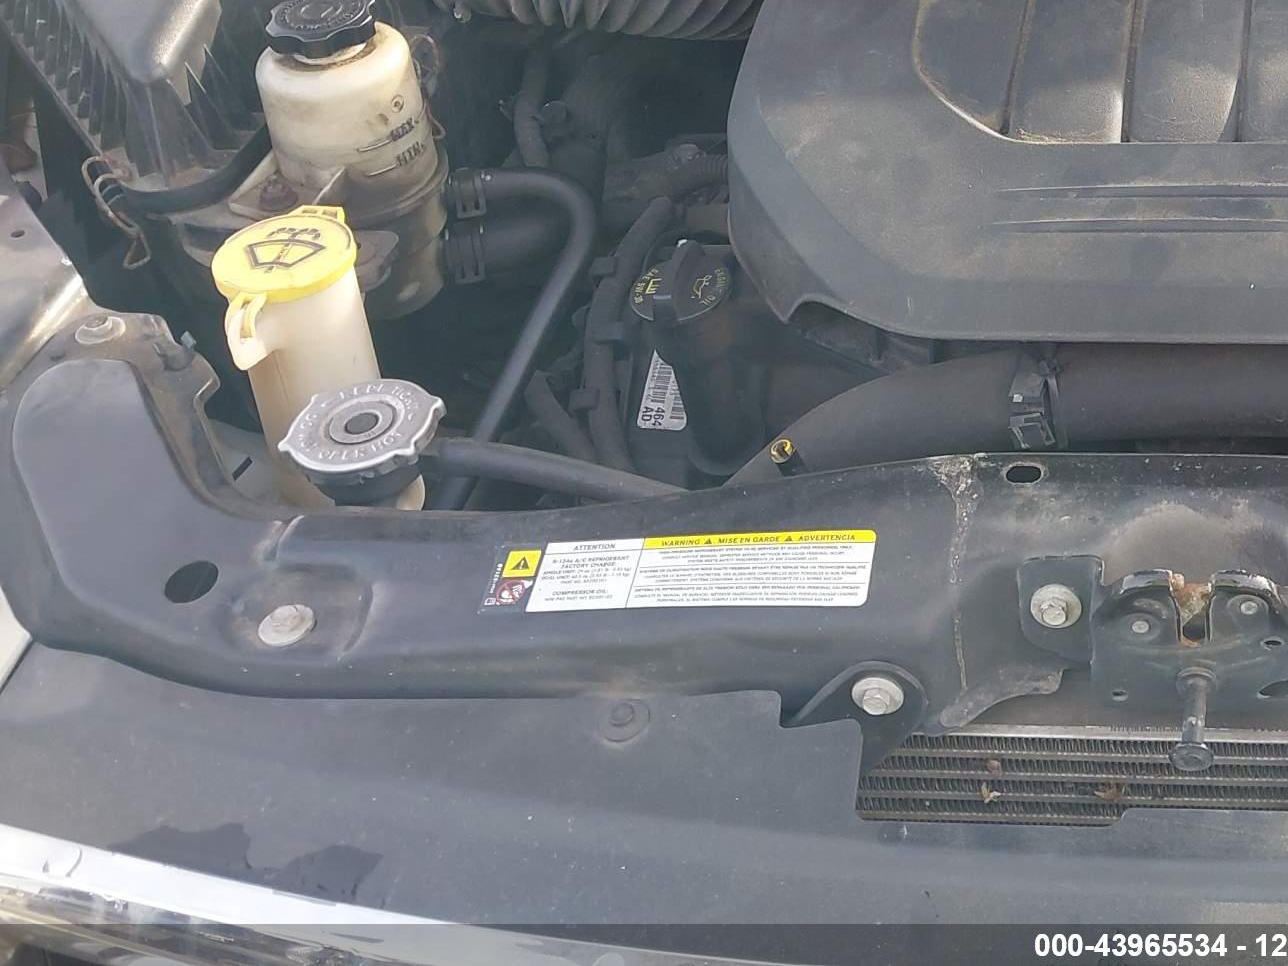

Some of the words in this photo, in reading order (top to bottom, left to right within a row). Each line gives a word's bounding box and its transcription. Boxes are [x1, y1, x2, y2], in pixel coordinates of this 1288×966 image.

[641, 405, 653, 422] AD
[652, 406, 665, 427] 464
[752, 535, 780, 543] GARDE
[798, 533, 856, 542] ADVERTENCIA
[573, 543, 616, 551] ATTENTION
[661, 538, 701, 547] WARNING
